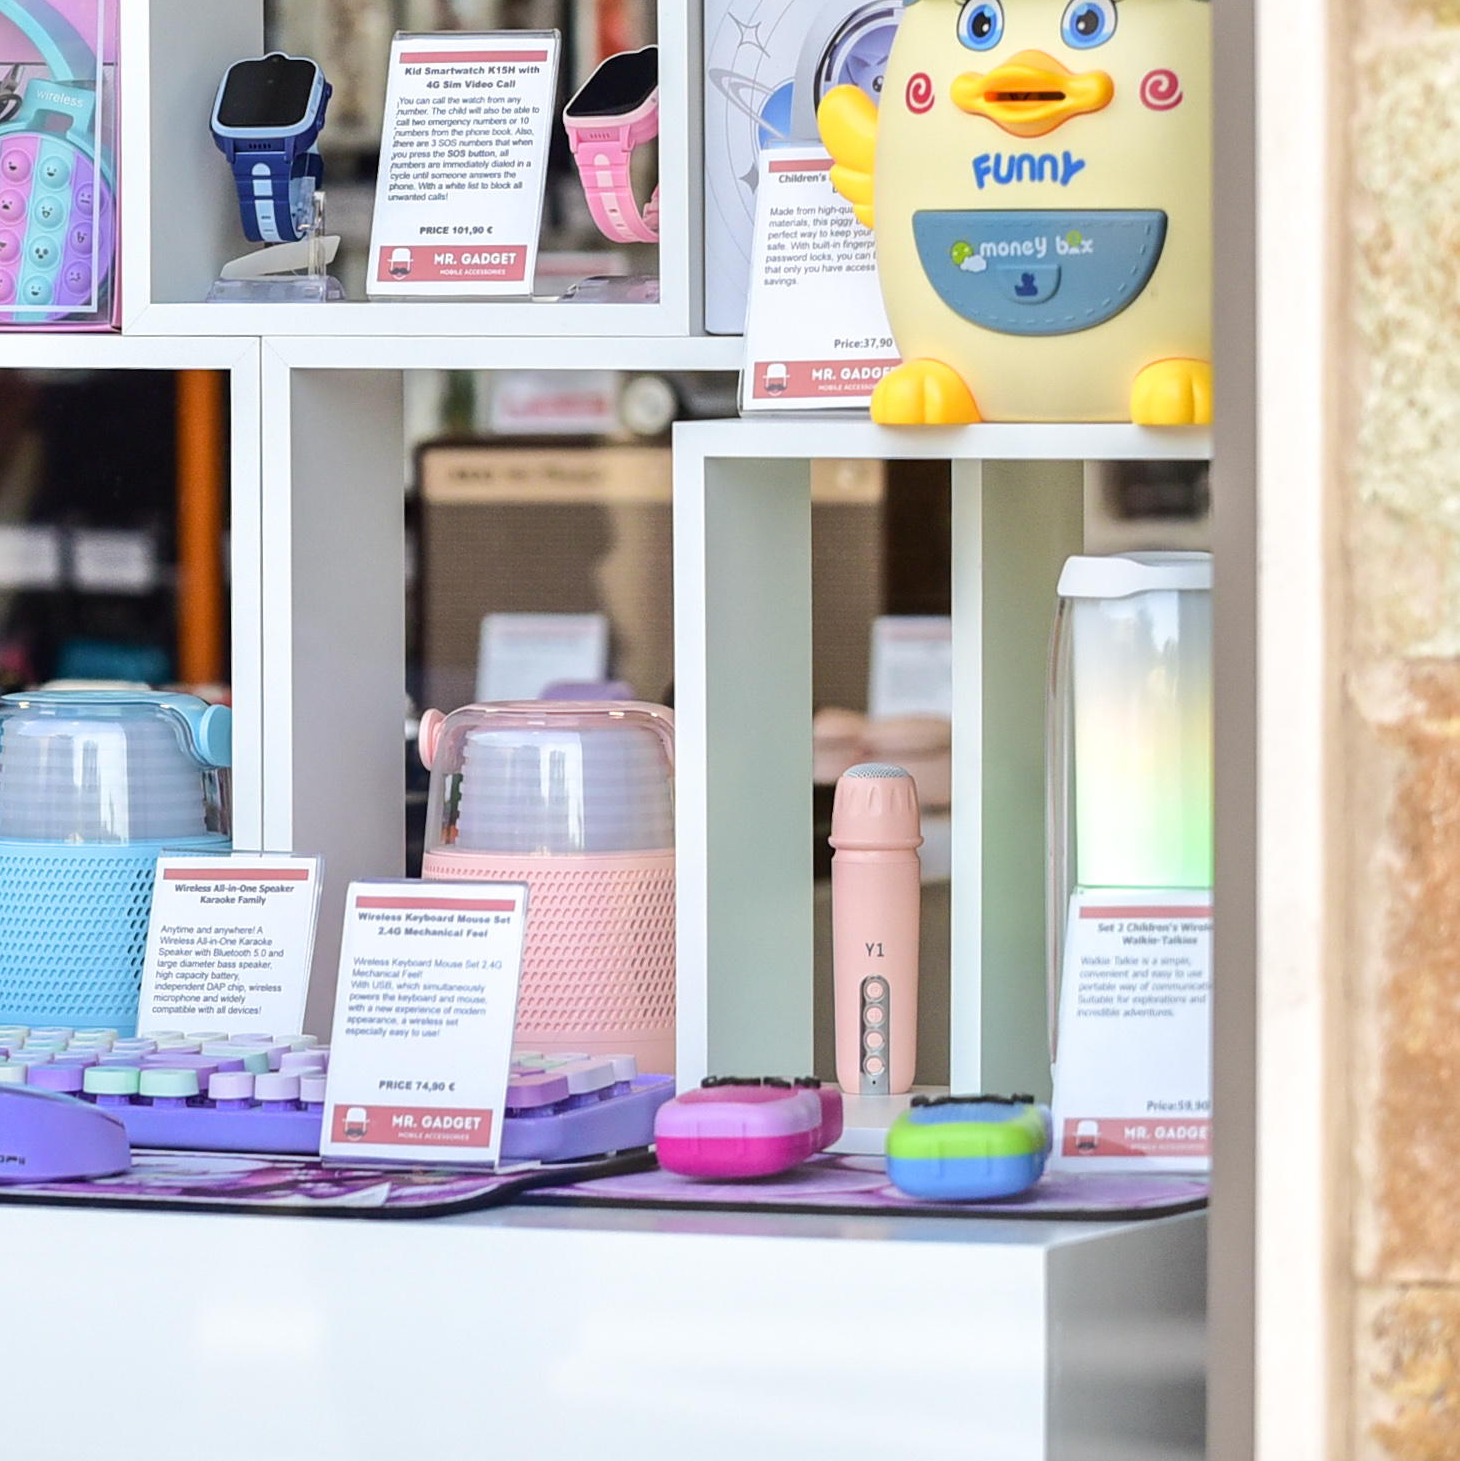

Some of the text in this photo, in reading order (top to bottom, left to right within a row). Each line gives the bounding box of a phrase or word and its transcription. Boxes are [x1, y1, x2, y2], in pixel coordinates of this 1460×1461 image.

[404, 65, 539, 75] Kid Smartwatch K15H with
[425, 79, 515, 88] 4G Sim Video Call
[35, 87, 84, 109] wireless
[778, 172, 826, 183] Children's
[768, 216, 853, 227] materials, this piggy
[419, 226, 449, 234] PRICE
[452, 225, 484, 235] 101,90
[767, 228, 874, 240] perfect way to keep your
[980, 234, 1047, 260] money
[433, 252, 516, 264] MR. GADGET
[765, 252, 871, 264] password locks, you can
[833, 337, 893, 348] Price:37,90
[174, 883, 294, 894] Wireless All-in-One Speaker
[199, 895, 266, 905] Karaoke Family
[357, 912, 510, 924] Wireless Keyboard Mouse Set
[377, 926, 487, 937] 2.4G Mechanical Feel
[158, 947, 284, 957] Speaker with Bluetooth 5.0 and
[864, 942, 886, 959] Y1
[151, 1004, 261, 1014] compatible with all devices!
[378, 1079, 412, 1090] PRICE
[415, 1081, 445, 1092] 74,90
[391, 1114, 481, 1129] MR. GADGET
